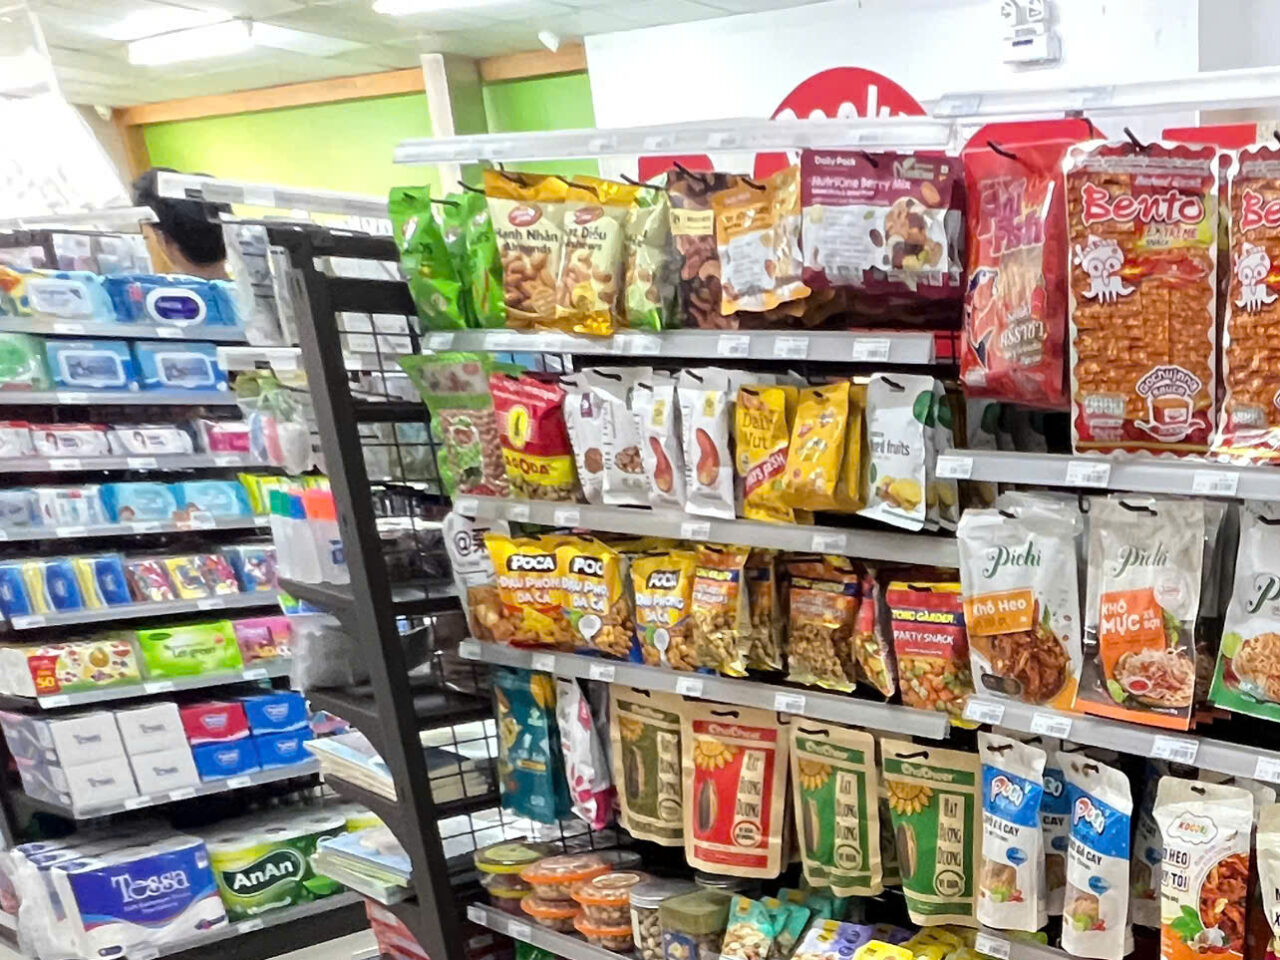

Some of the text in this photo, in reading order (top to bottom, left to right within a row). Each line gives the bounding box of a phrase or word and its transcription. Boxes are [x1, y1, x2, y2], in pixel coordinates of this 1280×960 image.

[1081, 182, 1205, 227] Bento
[511, 555, 556, 571] POCA
[983, 541, 1042, 579] Pichi
[1101, 615, 1140, 636] MỰC
[893, 632, 954, 647] PARTY SNACK
[1169, 849, 1189, 866] HEO
[111, 869, 191, 903] Tessa
[233, 860, 295, 891] AnAn
